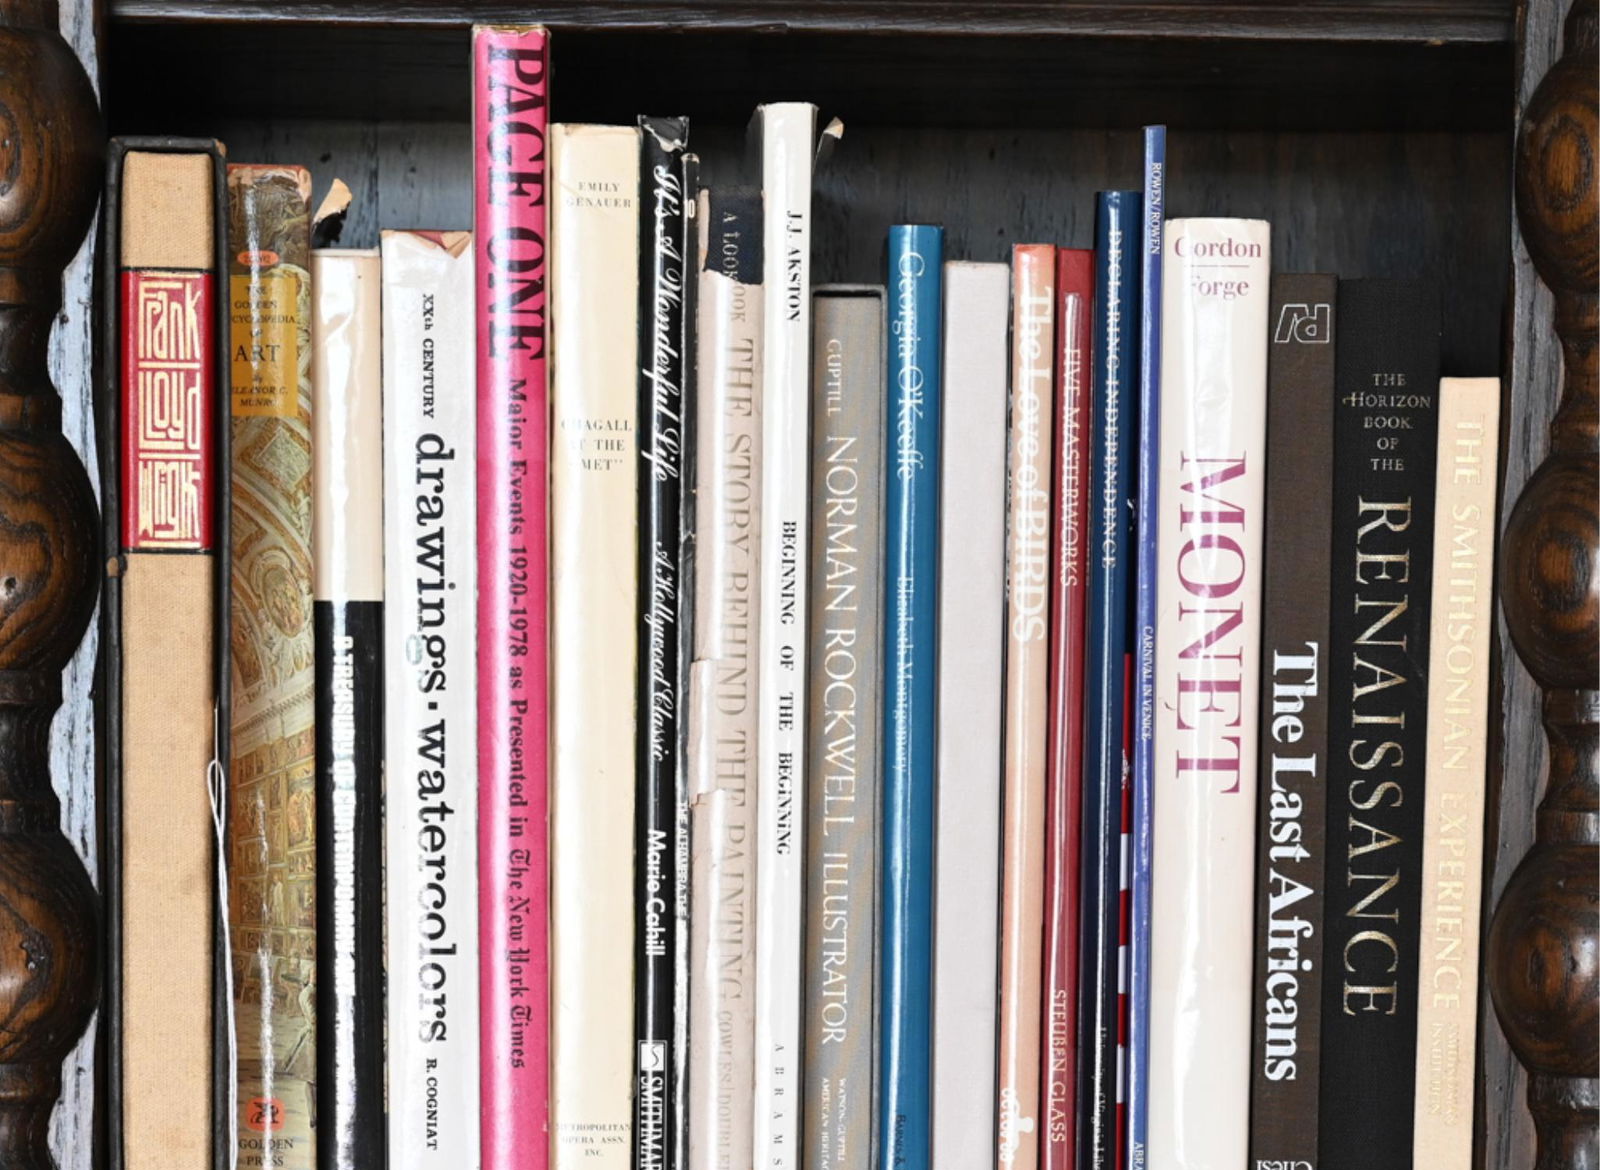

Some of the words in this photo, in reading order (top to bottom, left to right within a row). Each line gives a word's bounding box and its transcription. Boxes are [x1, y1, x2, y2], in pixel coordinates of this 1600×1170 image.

[488, 45, 544, 206] PAGE
[654, 166, 679, 220] It's
[1149, 163, 1161, 254] ROWEN/ROWEN
[657, 227, 681, 257] A
[487, 228, 544, 361] ONE
[787, 247, 801, 322] AKSTON
[893, 252, 923, 356] Georgia
[1018, 287, 1052, 358] The
[423, 338, 434, 418] CENTURY
[644, 269, 681, 414] Wonderful
[725, 339, 753, 416] THE
[826, 339, 842, 416] GUPTILL
[1372, 374, 1405, 386] THE
[506, 379, 526, 450] Major
[896, 366, 923, 480] O'Keeffe
[1017, 367, 1050, 466] Love
[1342, 393, 1430, 408] HORIZON
[1363, 416, 1412, 428] BOOK
[642, 426, 681, 480] Life
[1371, 458, 1404, 471] THE
[1377, 438, 1398, 449] OF
[1453, 414, 1485, 483] THE
[508, 460, 526, 534] Events
[723, 433, 751, 554] STORY
[824, 436, 858, 611] NORMAN
[1017, 469, 1047, 505] of
[405, 434, 456, 692] drawings
[508, 545, 527, 656] 1920-1978
[780, 521, 797, 623] BEGINNING
[1013, 509, 1048, 641] BIRDS
[715, 570, 750, 716] BEHIND
[780, 646, 795, 670] OF
[1176, 451, 1246, 793] MONET
[1443, 504, 1481, 769] SMITHSONIAN
[509, 667, 522, 689] as
[778, 693, 793, 730] THE
[1273, 641, 1318, 742] The
[508, 700, 528, 807] Presented
[716, 731, 748, 807] THE
[823, 629, 856, 835] ROCKWELL
[1343, 496, 1412, 1017] RENAISSANCE
[509, 817, 528, 837] in
[776, 752, 793, 855] BEGINNING
[1269, 752, 1316, 862] Last
[416, 720, 456, 1042] watercolors
[507, 849, 531, 889] The
[646, 830, 667, 891] Marie
[508, 896, 529, 940] New
[644, 899, 667, 956] Cahill
[714, 823, 748, 999] PAINTING
[1432, 792, 1469, 1009] EXPERIENCE
[504, 948, 528, 998] York
[821, 854, 848, 1044] ILLUSTRATOR
[1265, 869, 1314, 1081] Africans
[427, 1059, 437, 1072] R.
[509, 1005, 529, 1068] Times
[1051, 989, 1066, 1072] STEUBEN
[427, 1077, 437, 1150] COGNIAT
[1050, 1081, 1065, 1142] GLASS
